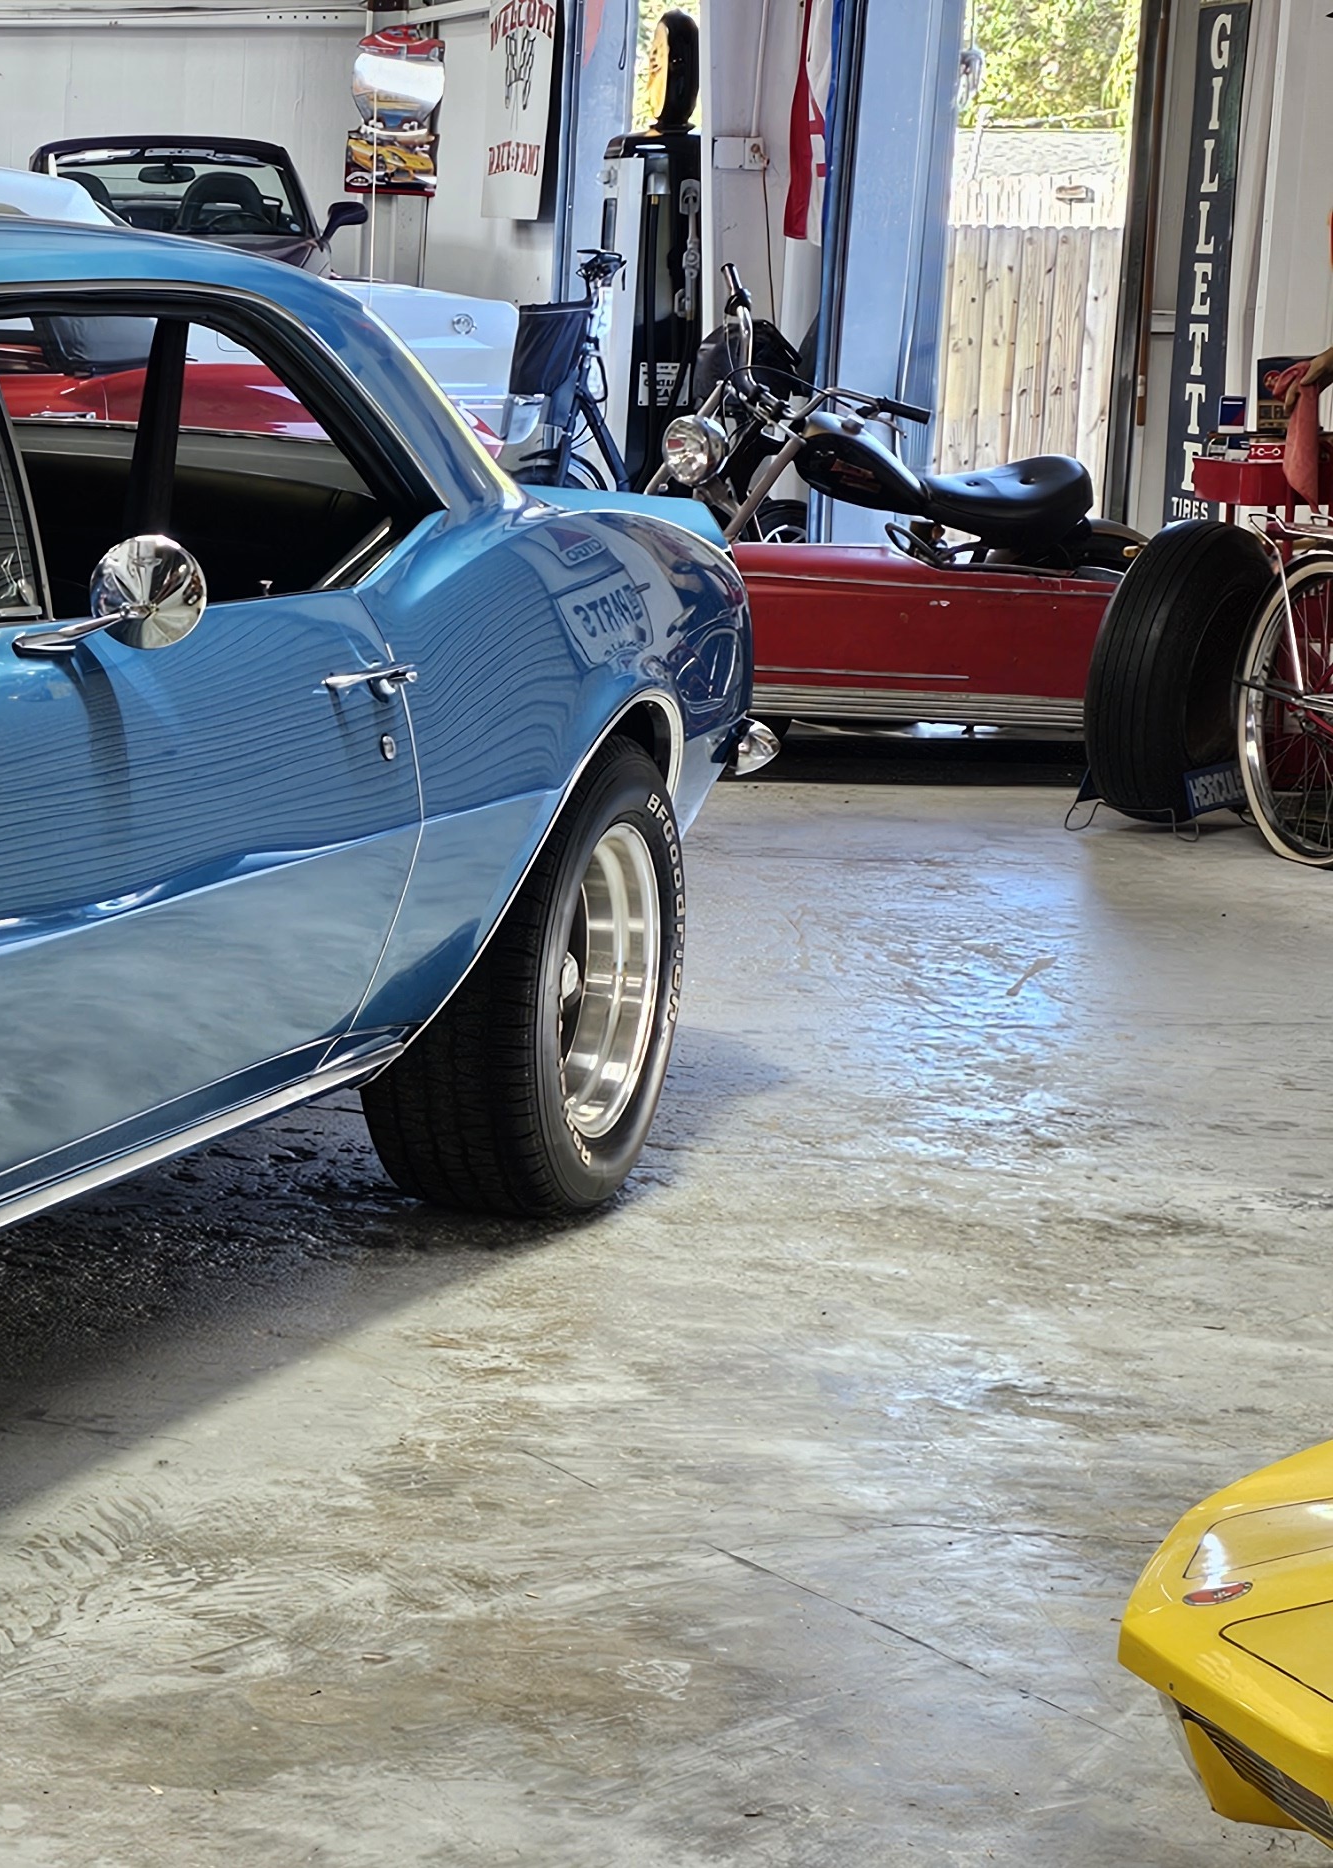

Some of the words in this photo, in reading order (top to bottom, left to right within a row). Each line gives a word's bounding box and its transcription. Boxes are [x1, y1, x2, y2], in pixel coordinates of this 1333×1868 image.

[1179, 13, 1232, 491] GILLETTE
[1171, 496, 1209, 520] TIRES
[646, 793, 686, 1023] BFGoodrich
